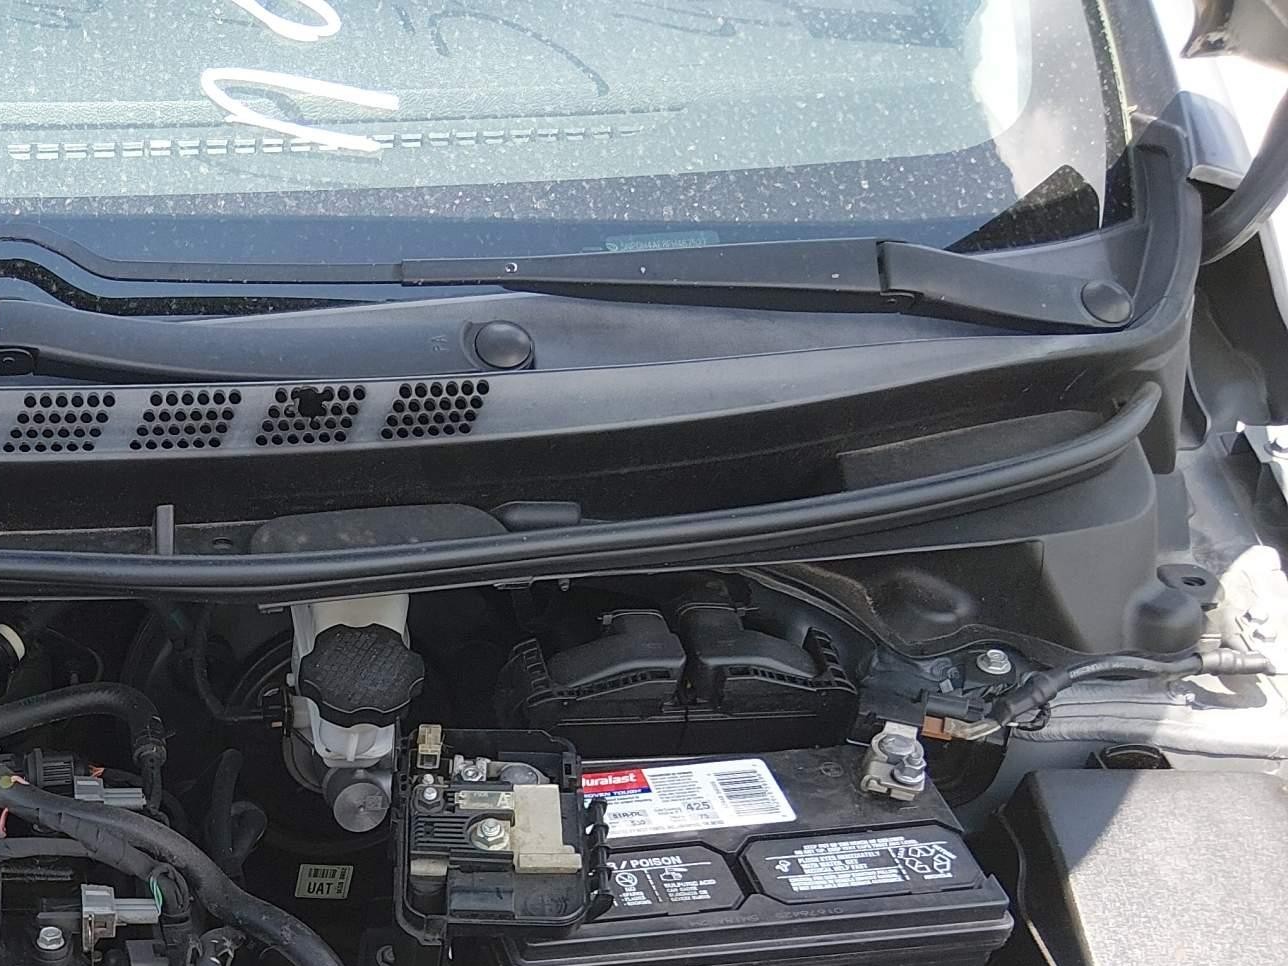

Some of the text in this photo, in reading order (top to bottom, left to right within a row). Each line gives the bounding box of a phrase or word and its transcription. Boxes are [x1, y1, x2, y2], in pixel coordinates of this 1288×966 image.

[581, 772, 637, 787] uralast
[686, 801, 710, 811] 425
[629, 855, 683, 868] POISON
[307, 881, 334, 895] UAT
